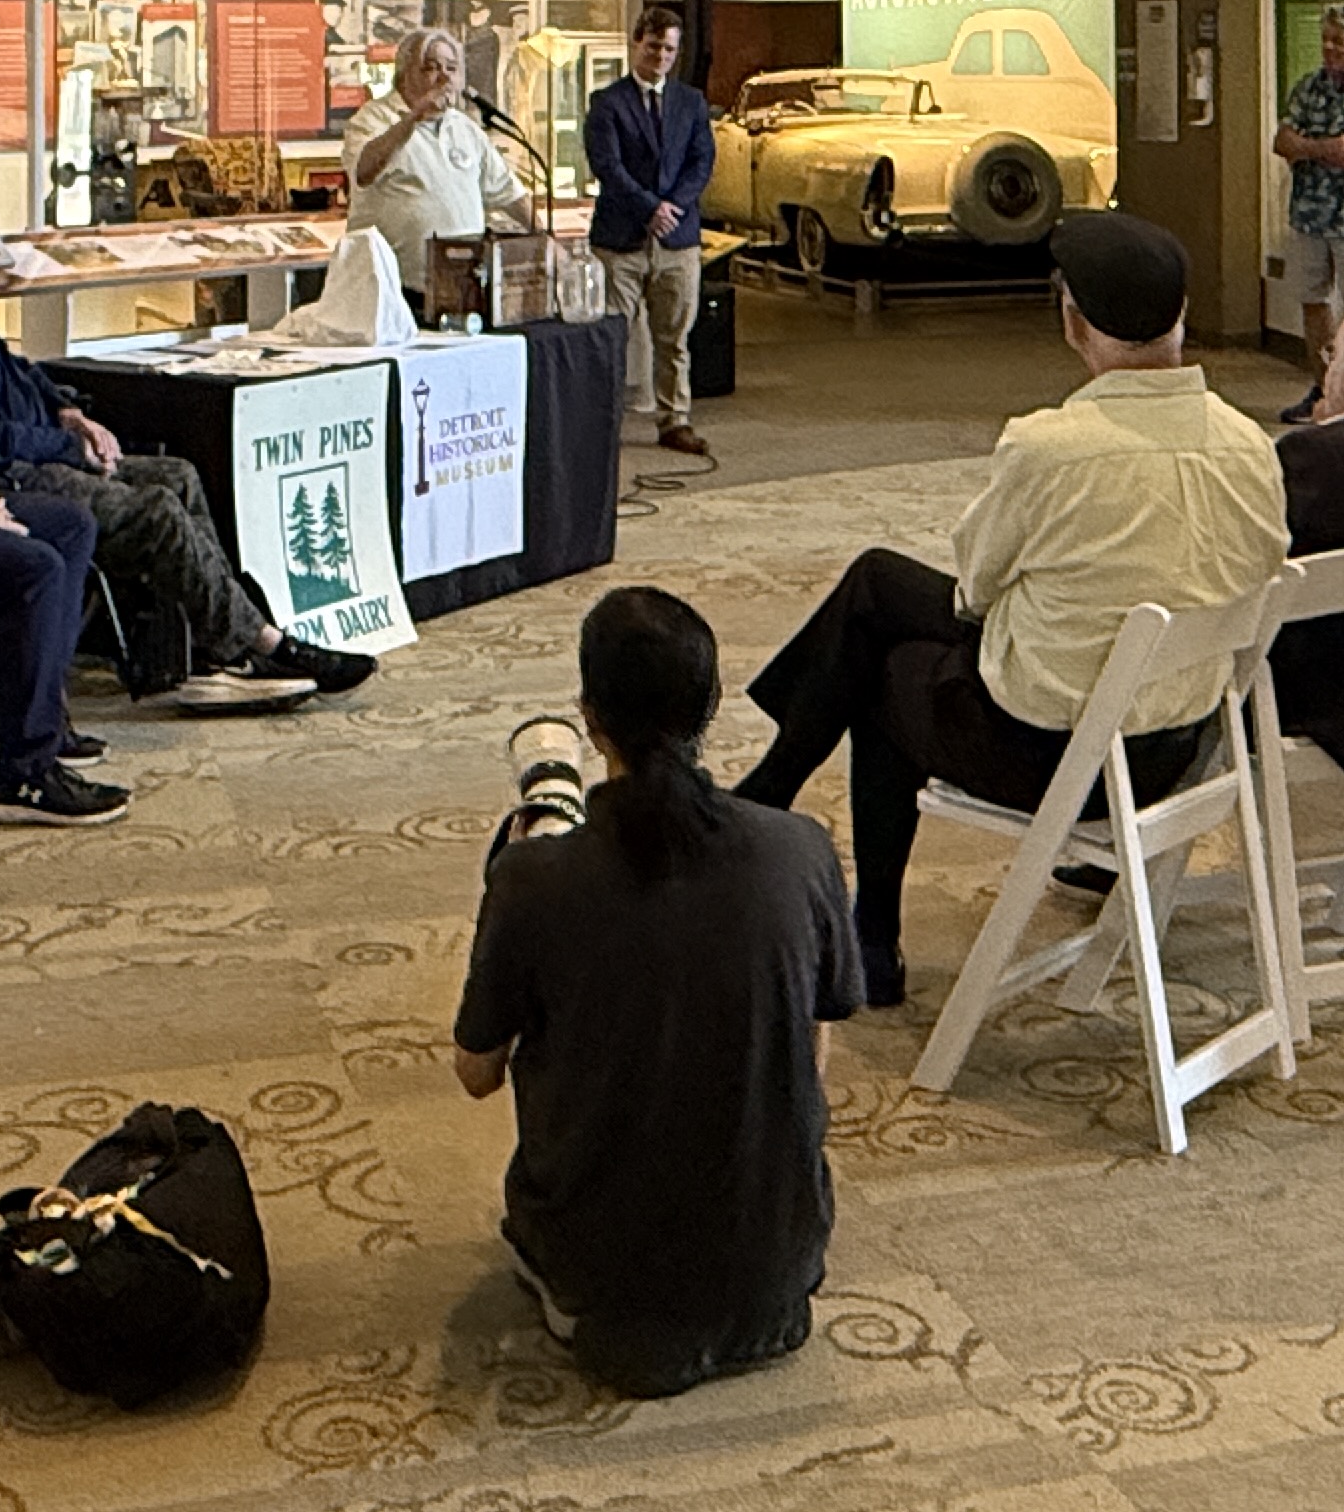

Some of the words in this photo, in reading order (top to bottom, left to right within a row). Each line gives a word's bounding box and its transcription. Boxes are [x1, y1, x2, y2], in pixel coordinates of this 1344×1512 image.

[438, 407, 507, 439] DETROIT
[252, 430, 305, 472] TWIN
[318, 417, 374, 458] PINES
[428, 425, 517, 464] HISTORICAL
[434, 452, 514, 486] MUSEUM
[335, 594, 395, 642] DAIRY
